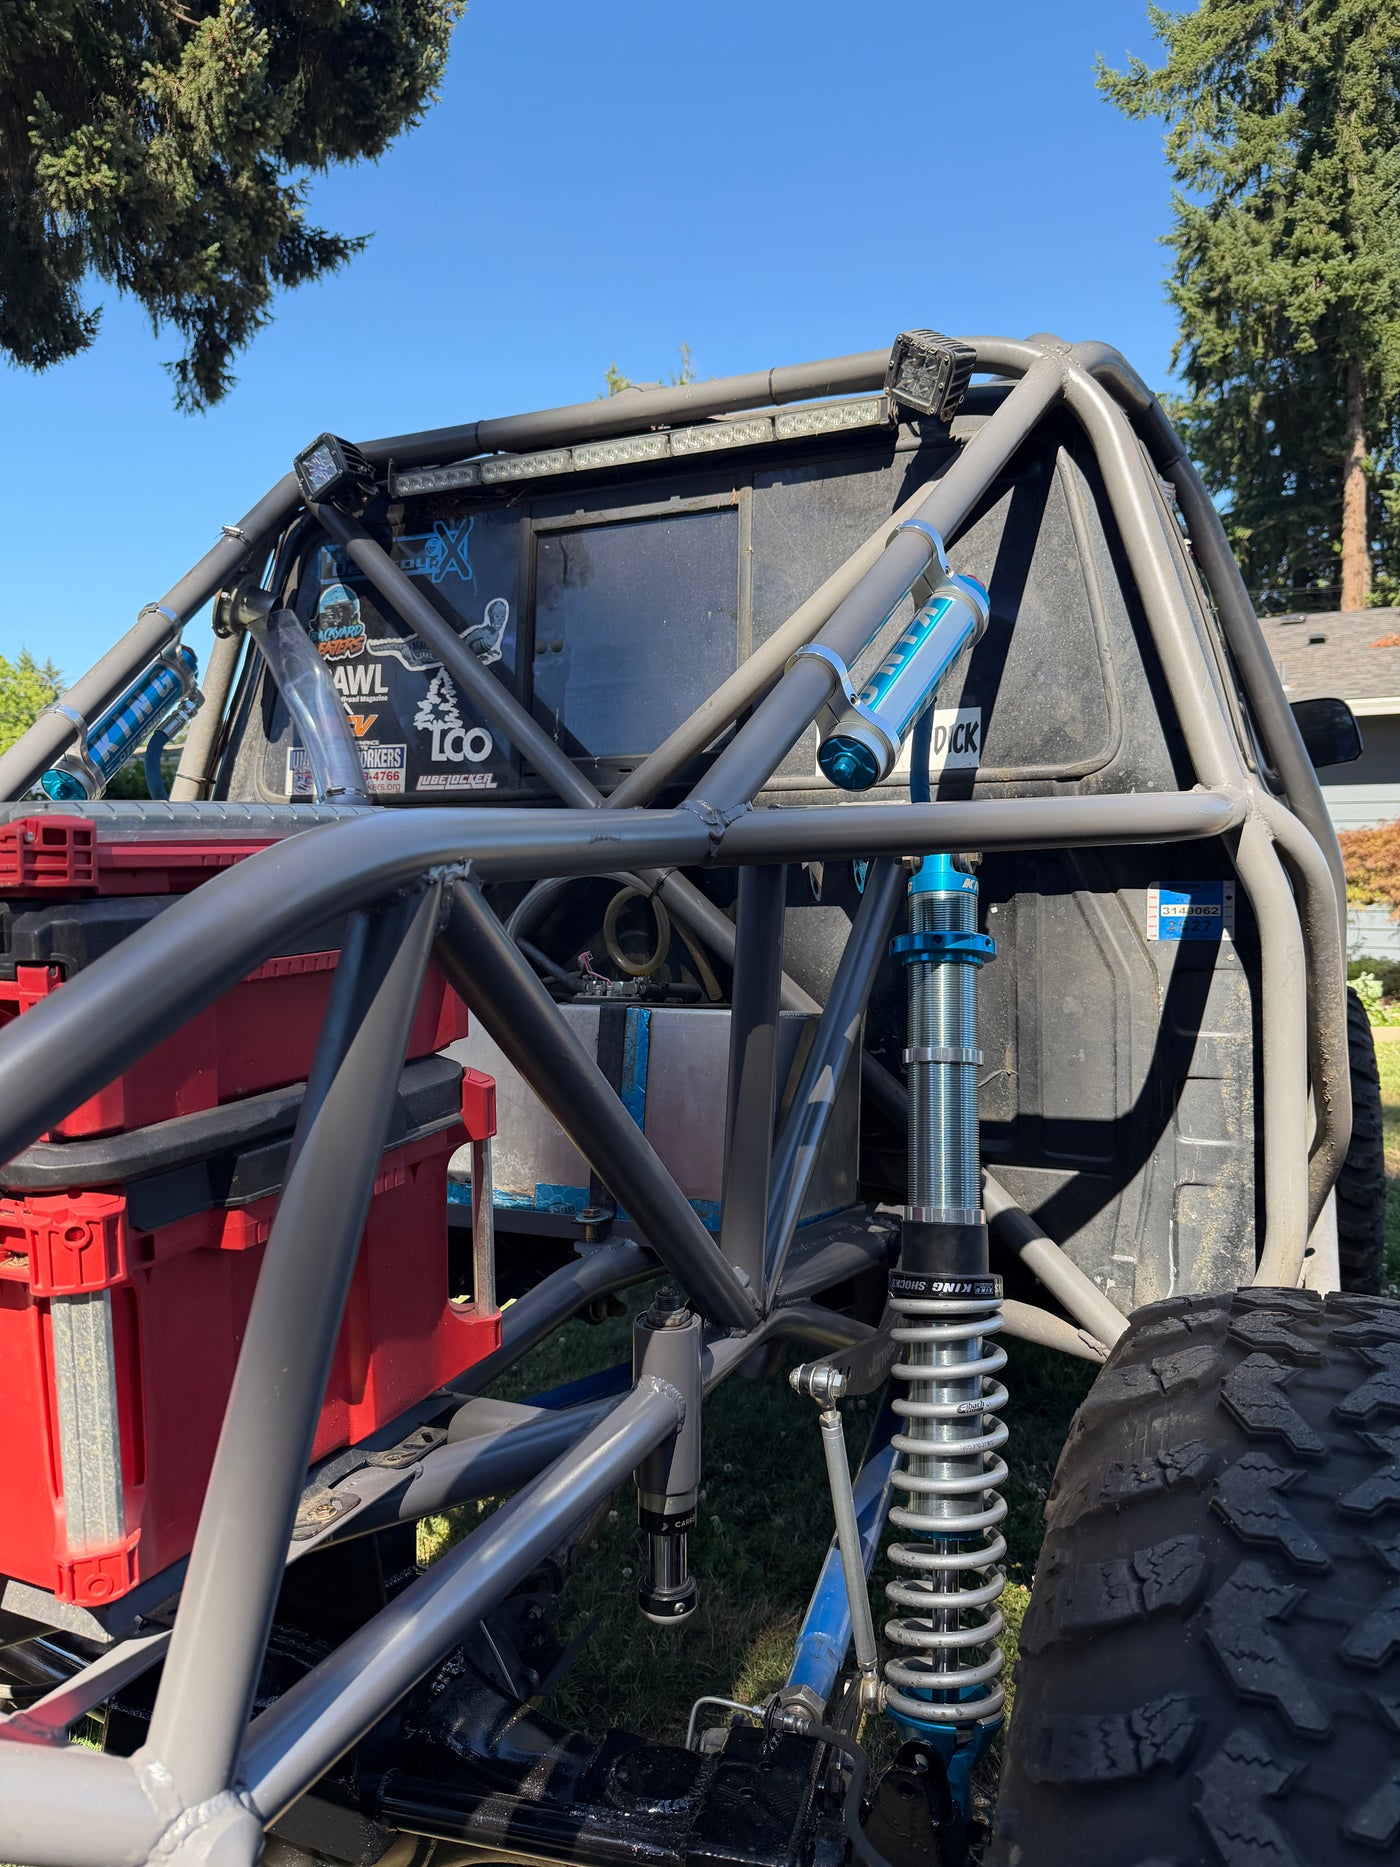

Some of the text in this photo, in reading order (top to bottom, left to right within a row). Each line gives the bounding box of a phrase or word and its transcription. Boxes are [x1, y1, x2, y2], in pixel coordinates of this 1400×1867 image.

[910, 339, 938, 354] RIGID
[331, 664, 389, 695] AWL
[360, 694, 389, 703] Magazine
[90, 668, 174, 763] KING
[431, 726, 493, 762] LCO
[933, 720, 979, 756] DICK
[360, 748, 401, 769] ORKERS
[416, 773, 498, 790] LUBELOCKER
[1162, 906, 1219, 915] 3149062
[1167, 920, 1212, 932] 2027
[891, 1278, 926, 1291] SHOCKS
[931, 1282, 973, 1293] KING
